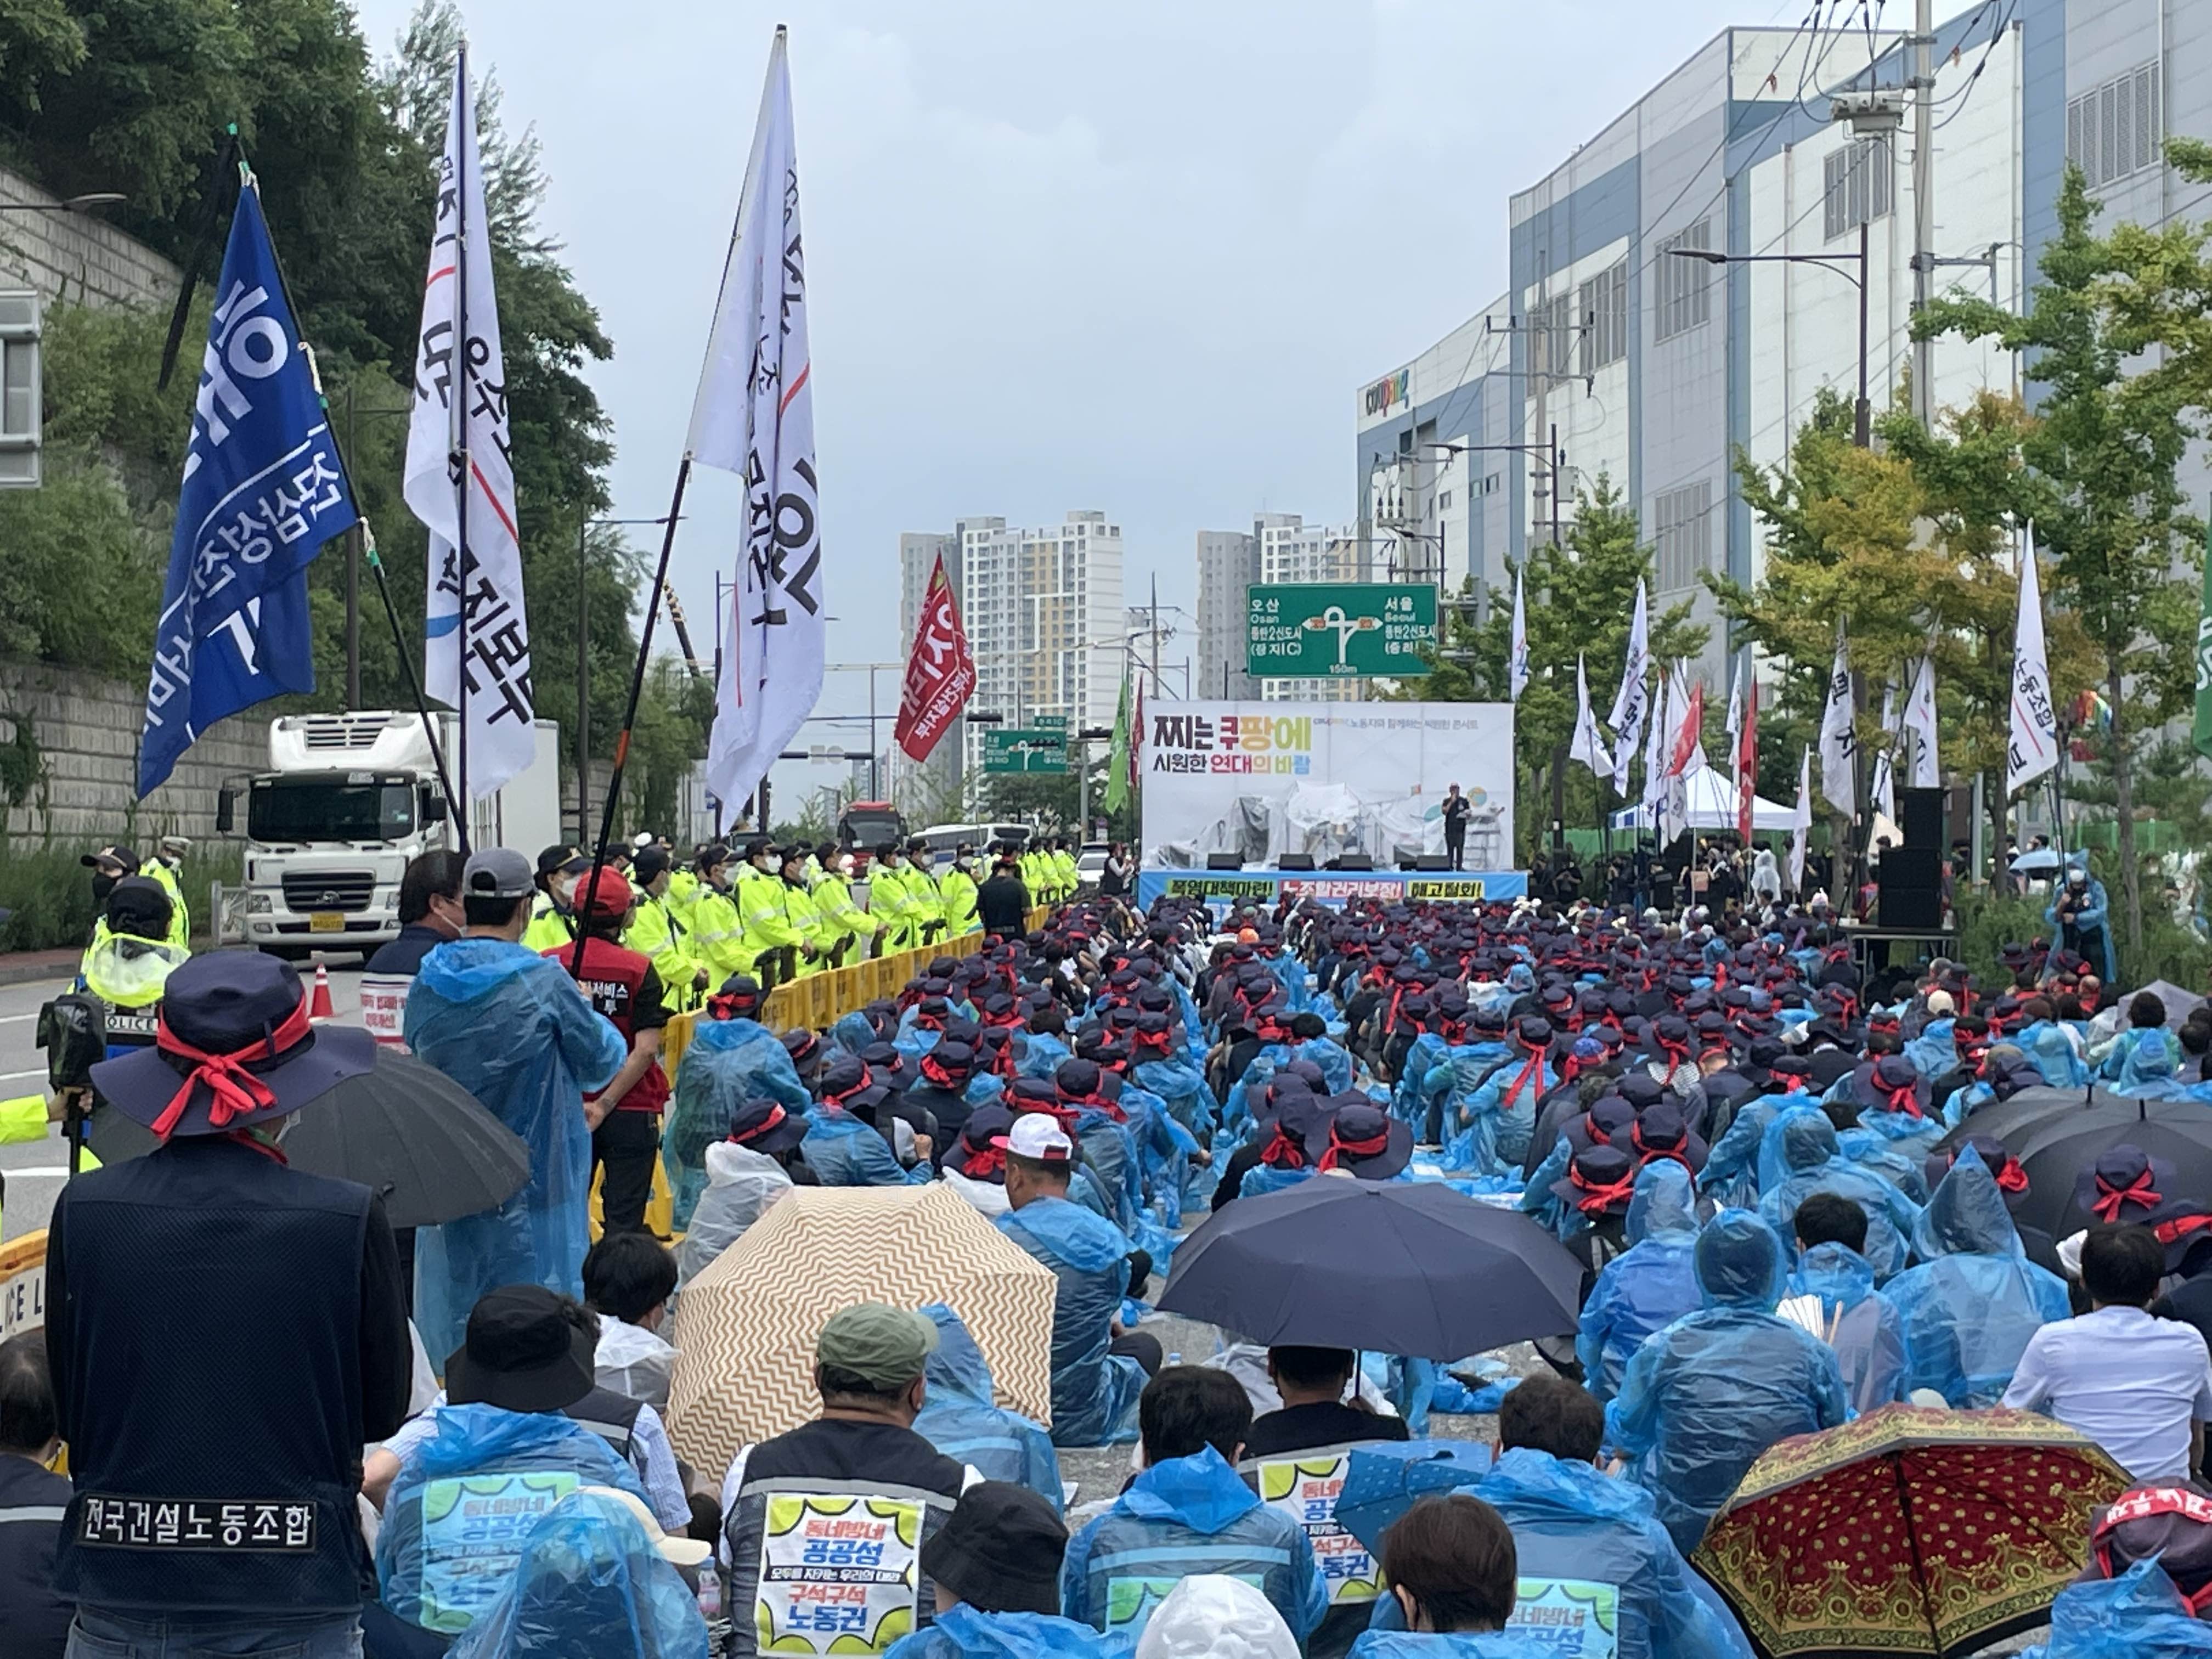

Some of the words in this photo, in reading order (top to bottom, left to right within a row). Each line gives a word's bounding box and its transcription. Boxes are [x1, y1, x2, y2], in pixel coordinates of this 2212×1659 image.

[1384, 596, 1414, 612] 서울
[1251, 614, 1279, 624] Osan
[1385, 612, 1416, 623] Seoul
[1153, 715, 1214, 750] 찌는
[1220, 716, 1312, 751] 쿠팡에
[1153, 753, 1206, 773] 시원한
[1211, 754, 1271, 774] 연대의
[1275, 754, 1311, 775] 바람
[85, 1498, 311, 1545] 전국건설노동조합
[804, 1519, 887, 1541] 동네방네
[803, 1539, 885, 1566] 공공성
[788, 1583, 867, 1605] 구석구석
[786, 1605, 868, 1632] 노동권
